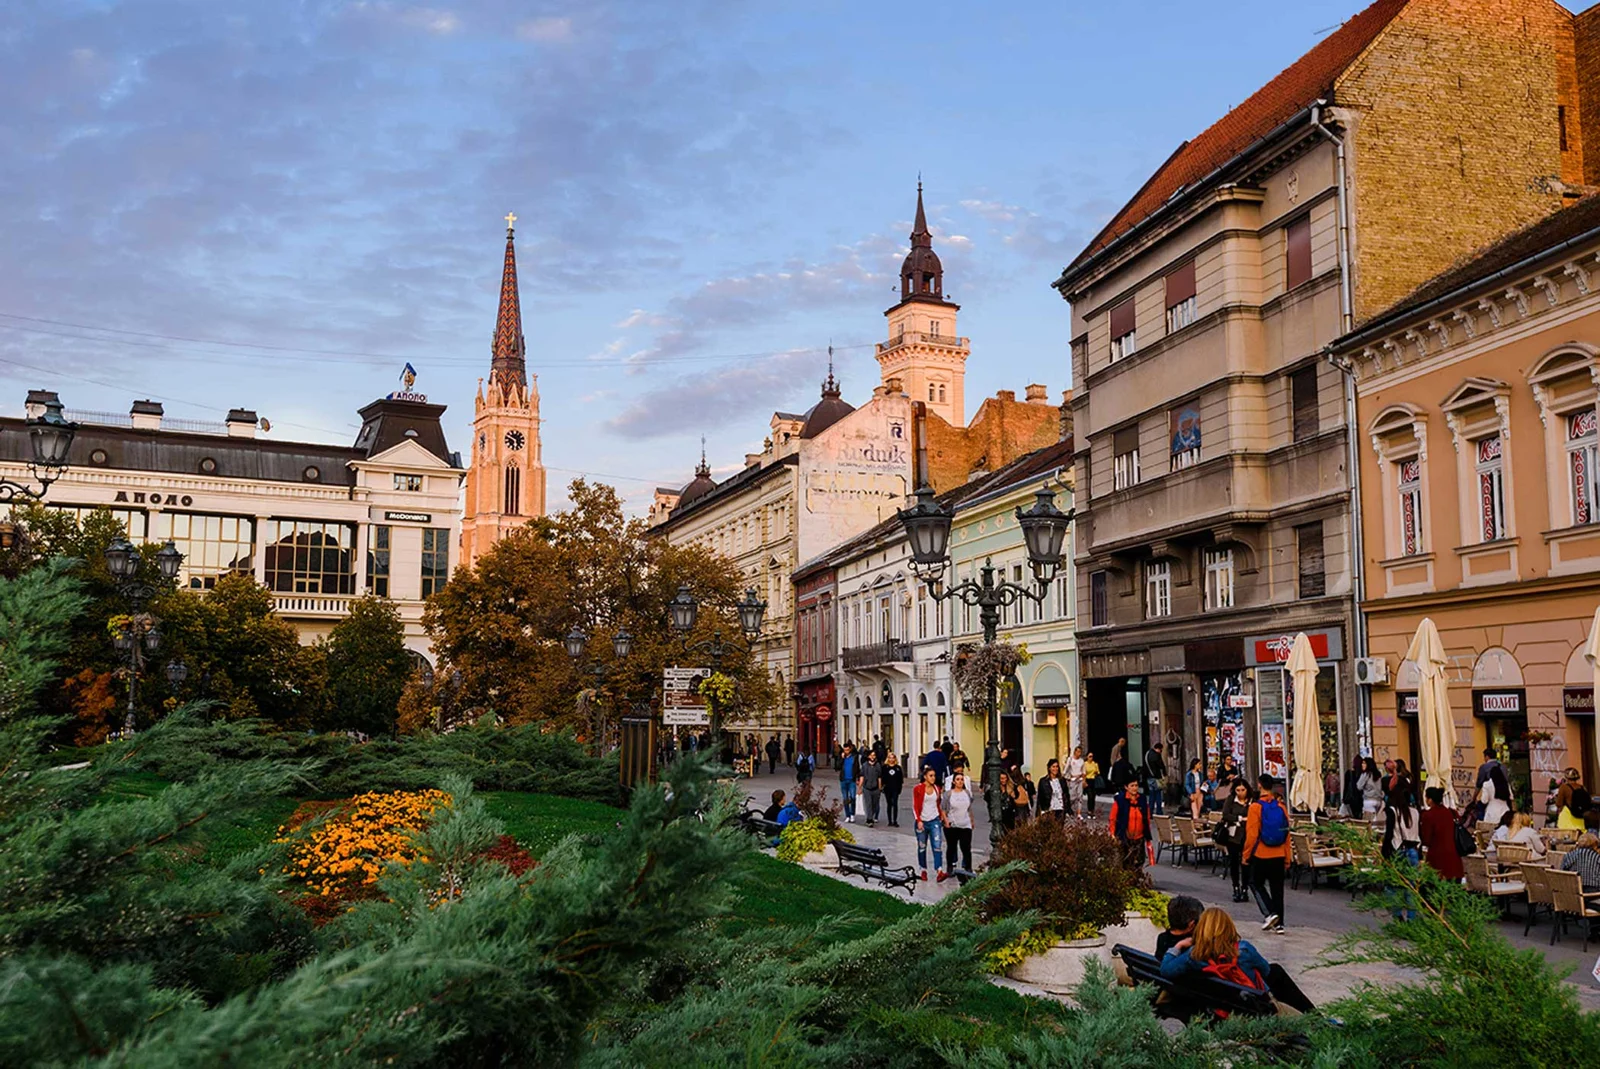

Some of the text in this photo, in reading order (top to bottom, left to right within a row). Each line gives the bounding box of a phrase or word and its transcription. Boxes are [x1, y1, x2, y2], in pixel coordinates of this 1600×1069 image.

[397, 391, 426, 402] АПОЛО
[836, 443, 906, 465] Rudnik
[1575, 451, 1586, 522] KODEKS
[114, 491, 193, 507] АПОЛО
[1482, 474, 1493, 539] KODEKS
[1404, 493, 1414, 554] KODEKS
[1484, 697, 1517, 709] НОЛИТ
